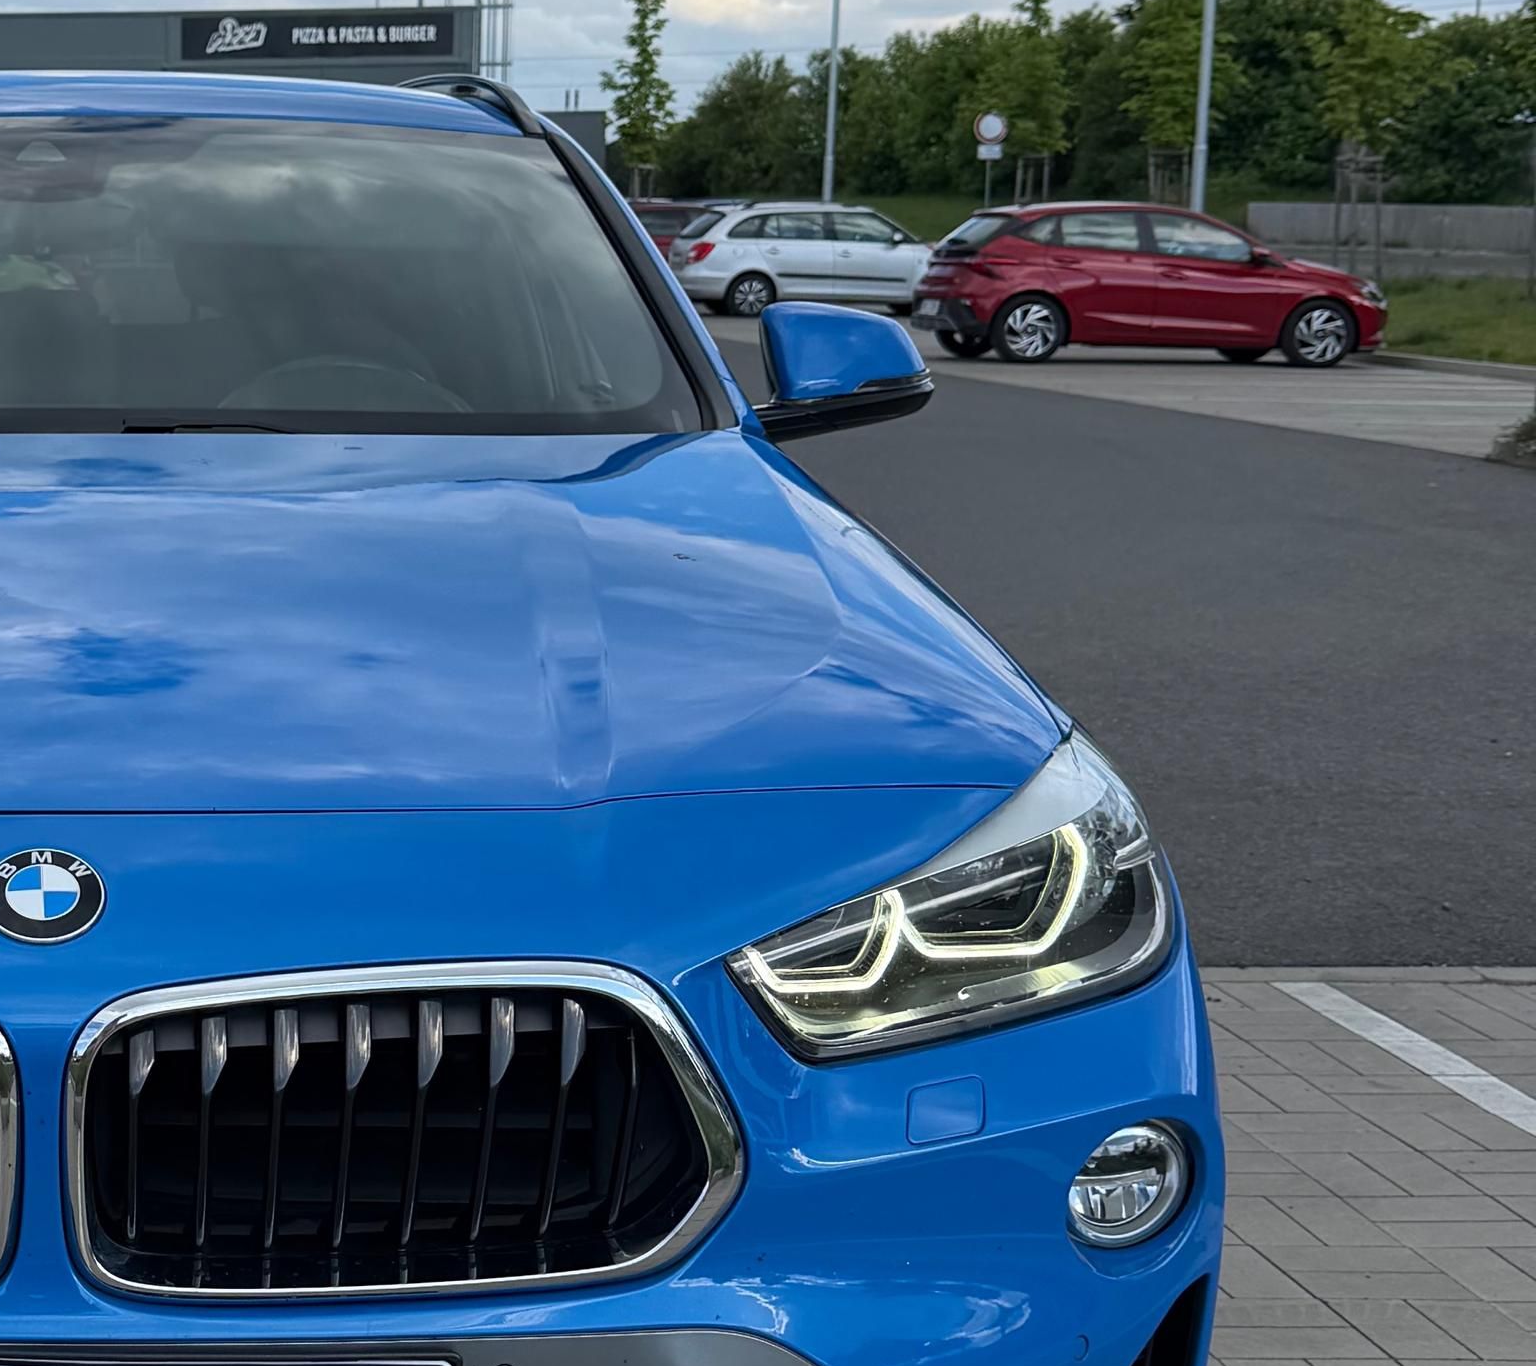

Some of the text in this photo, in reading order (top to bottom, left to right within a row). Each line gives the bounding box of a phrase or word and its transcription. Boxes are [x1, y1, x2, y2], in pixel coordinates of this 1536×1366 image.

[292, 24, 437, 44] PIZZA & PASTA & BURGER
